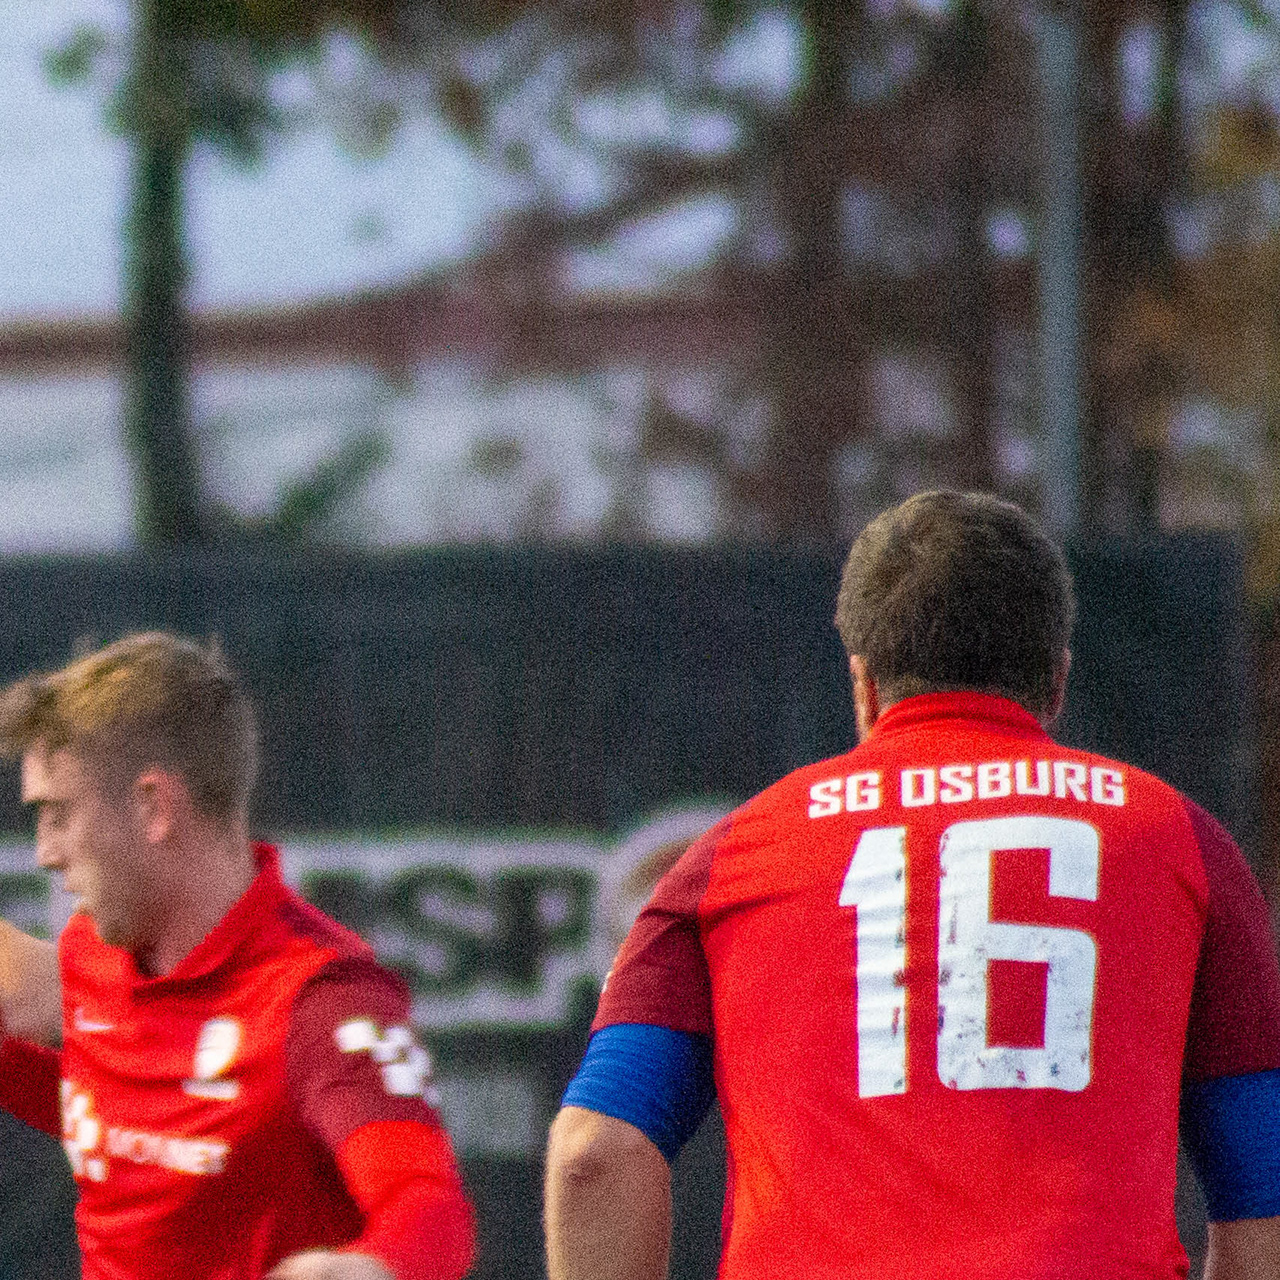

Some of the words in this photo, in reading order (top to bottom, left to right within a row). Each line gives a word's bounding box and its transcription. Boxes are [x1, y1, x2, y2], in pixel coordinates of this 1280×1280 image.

[807, 768, 883, 819] SG
[899, 760, 1128, 808] OSBURG
[837, 815, 1100, 1100] 16
